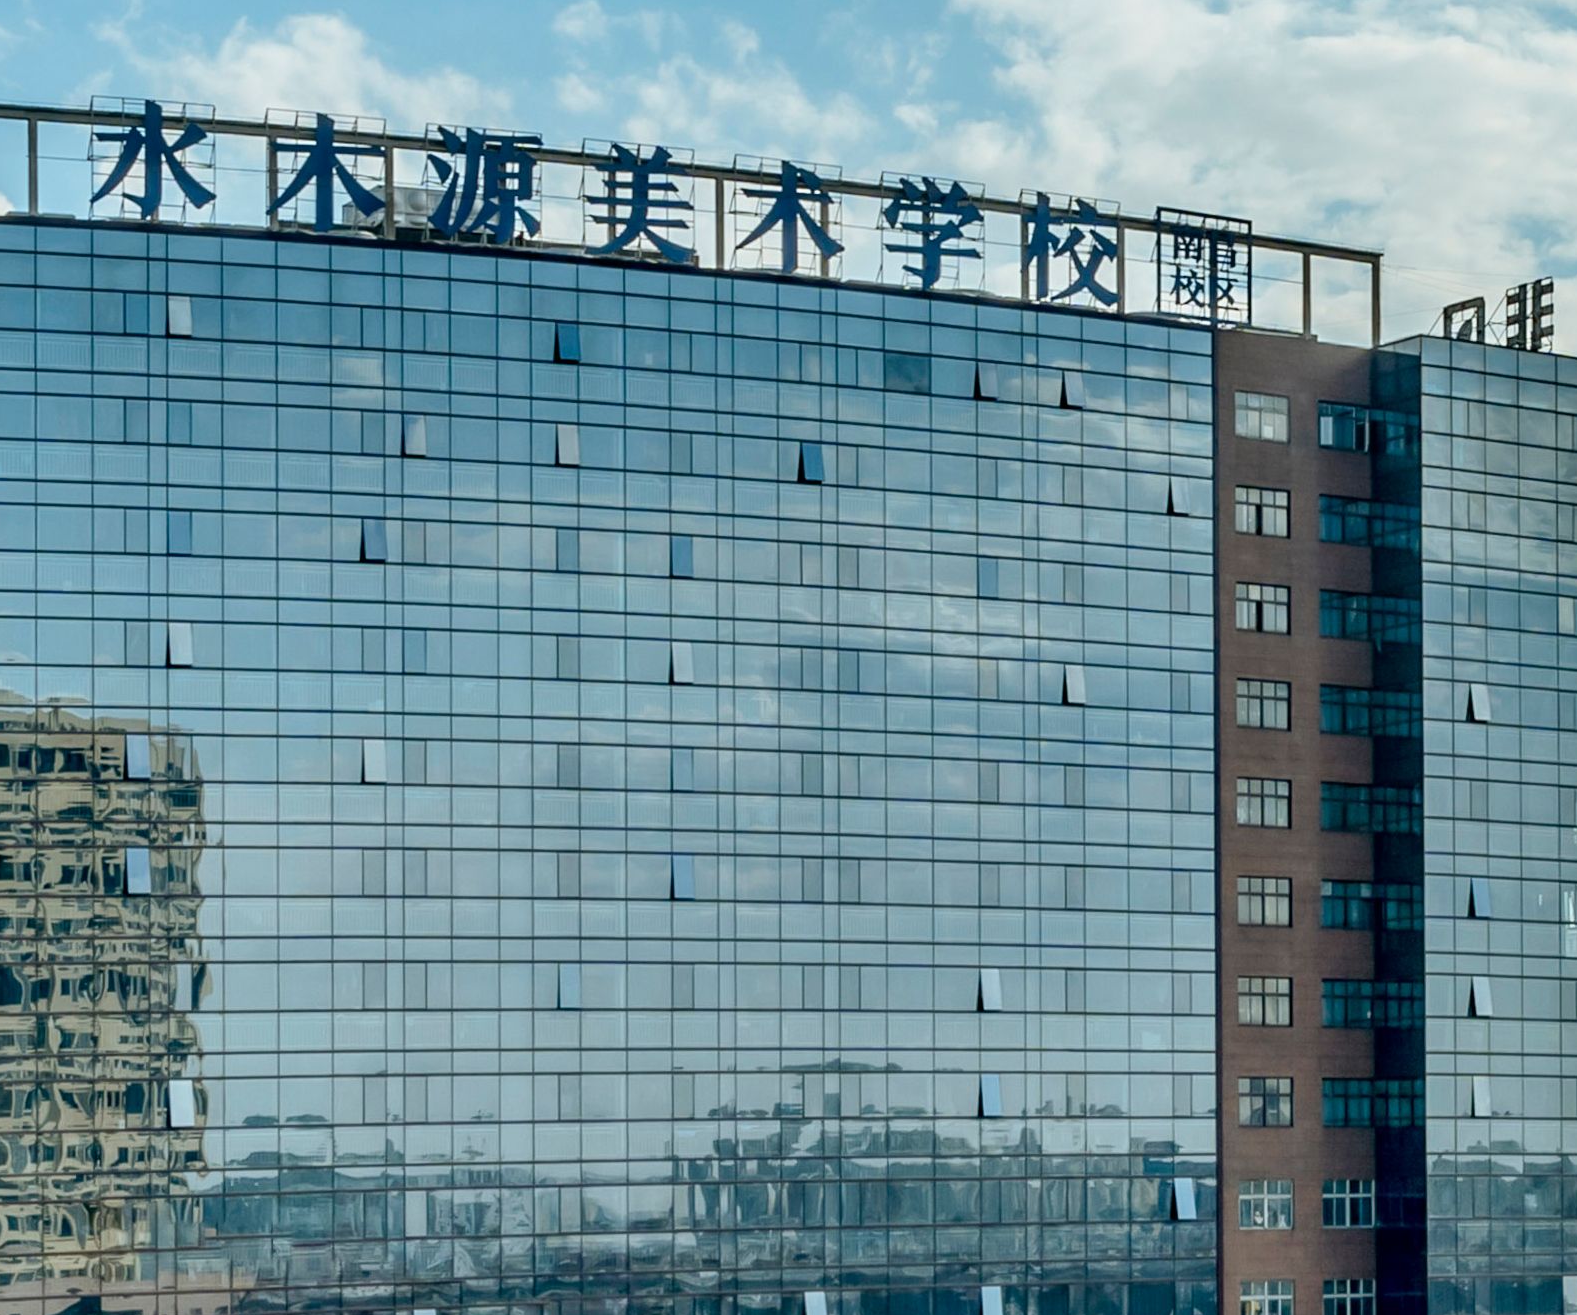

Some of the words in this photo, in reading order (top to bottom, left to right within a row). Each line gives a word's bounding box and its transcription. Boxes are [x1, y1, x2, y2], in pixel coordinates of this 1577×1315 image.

[89, 99, 1120, 307] 水木源美术学校
